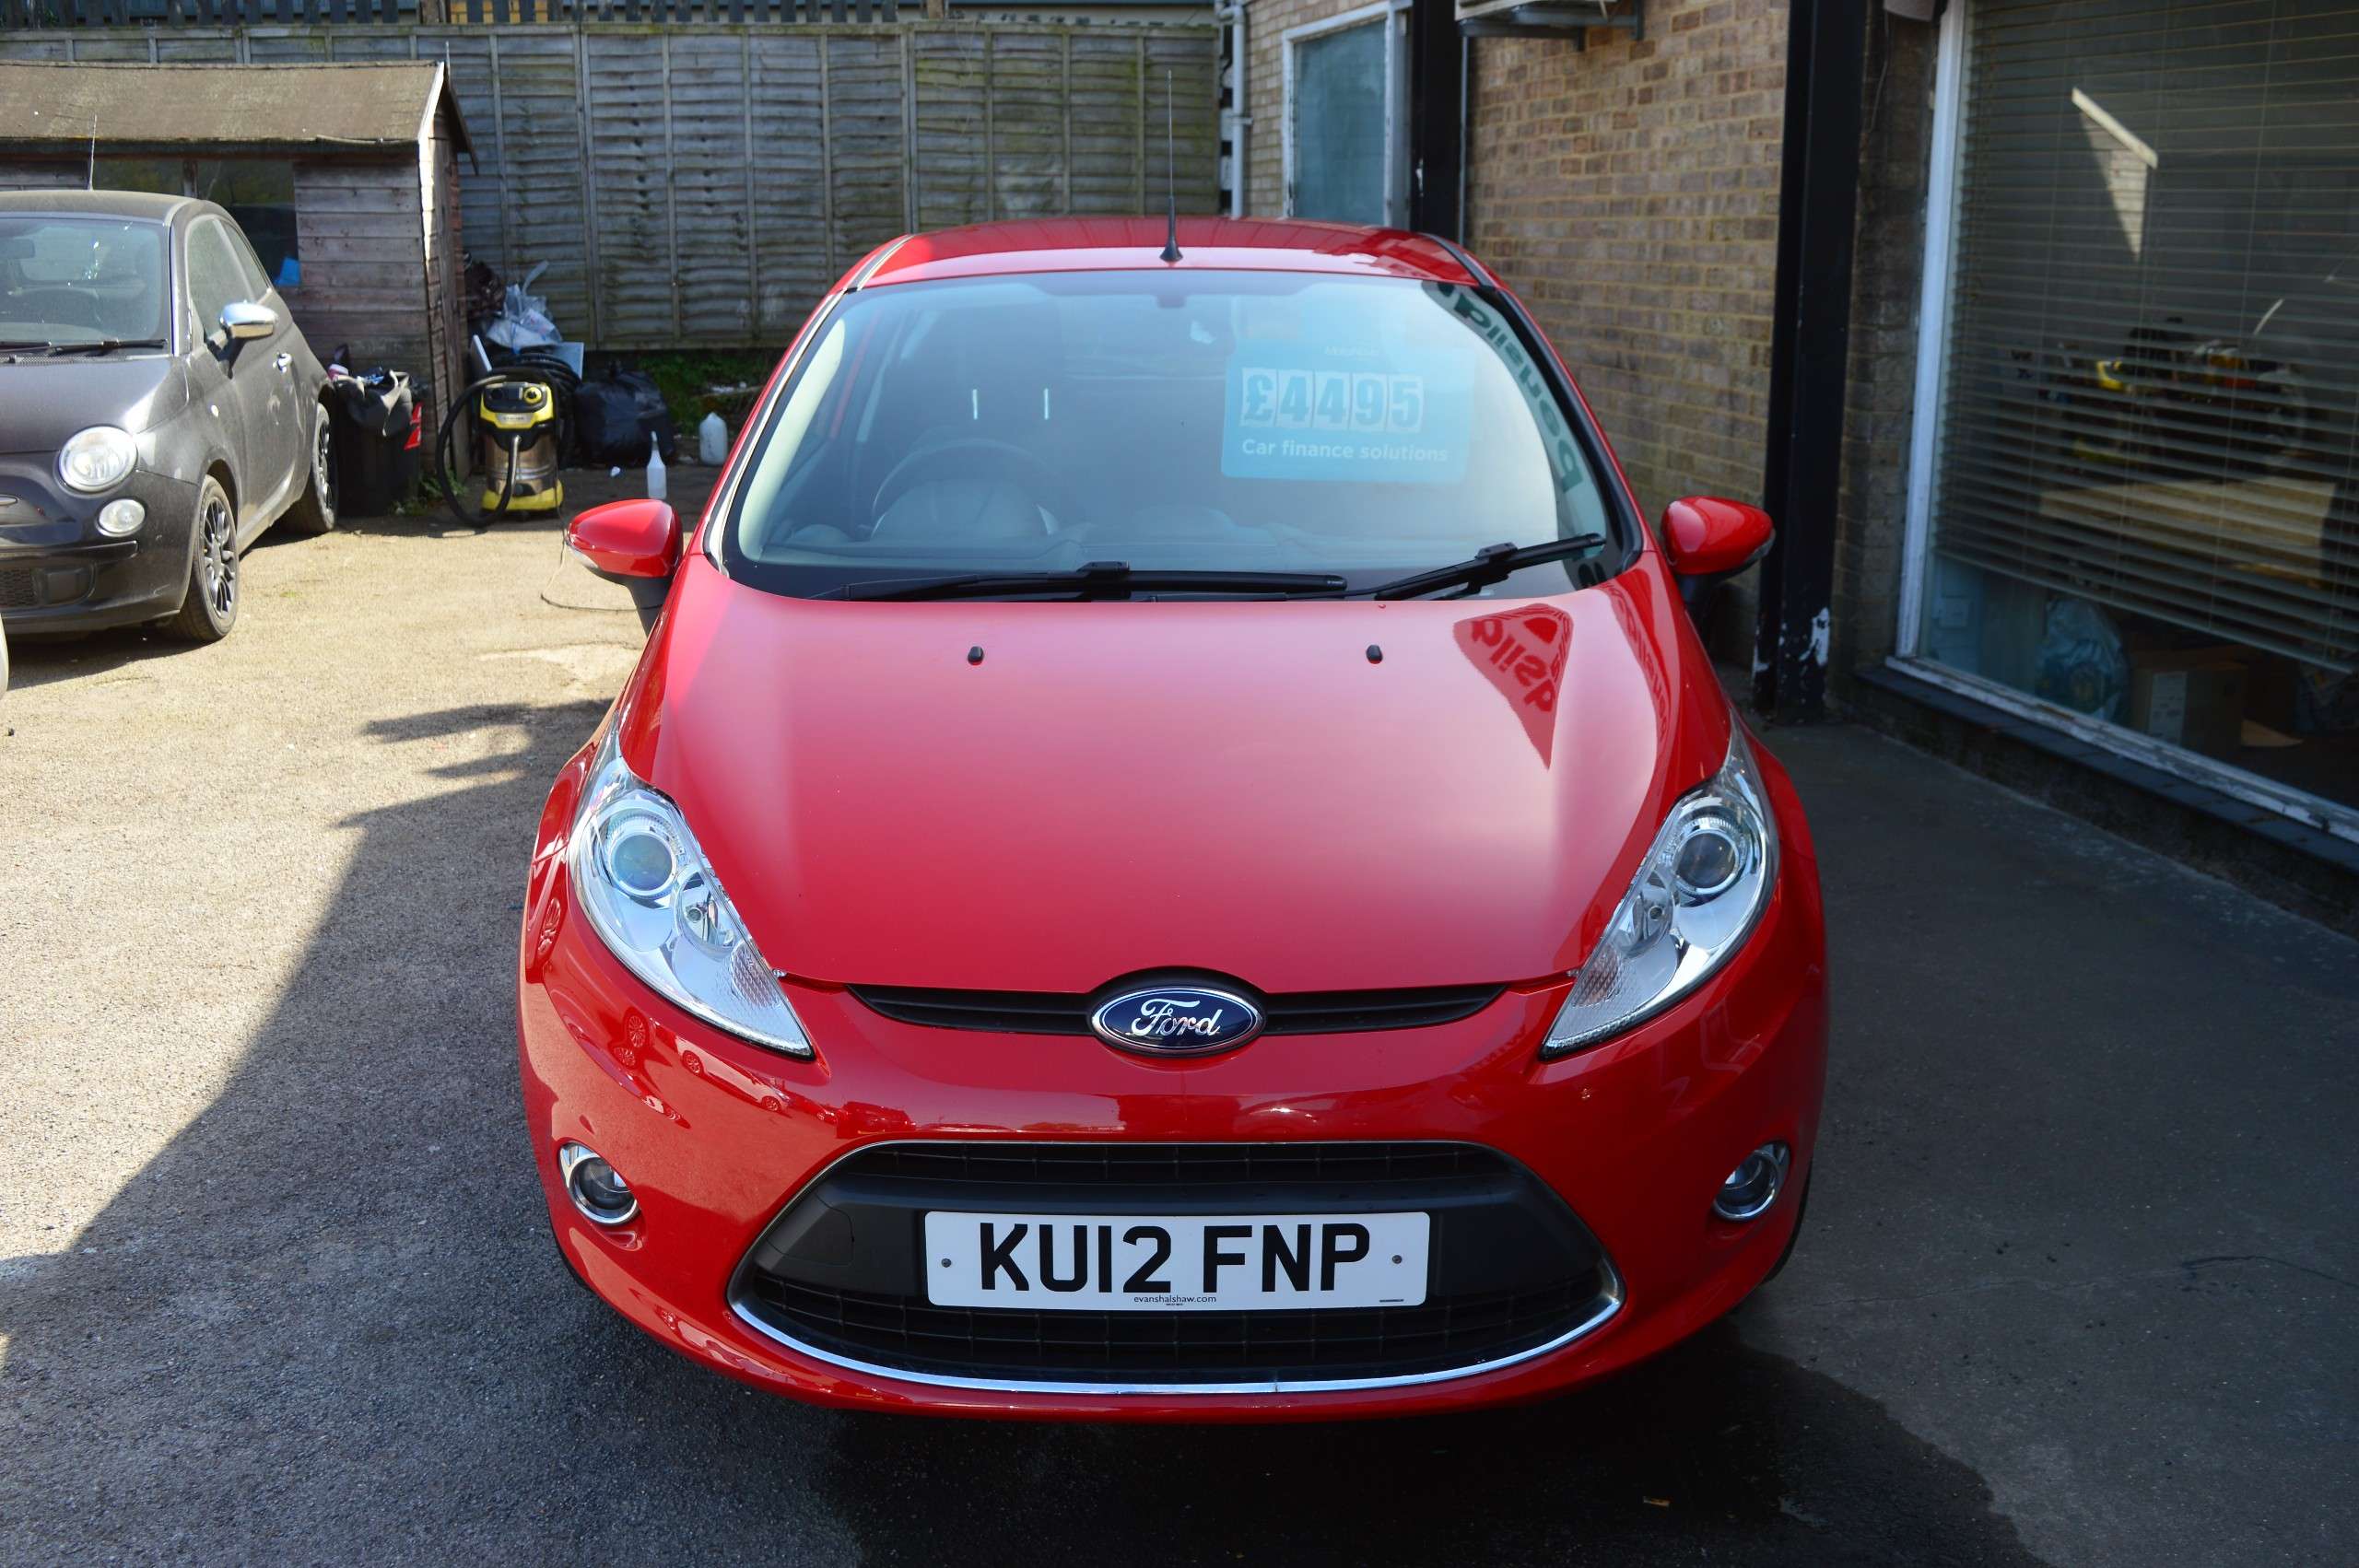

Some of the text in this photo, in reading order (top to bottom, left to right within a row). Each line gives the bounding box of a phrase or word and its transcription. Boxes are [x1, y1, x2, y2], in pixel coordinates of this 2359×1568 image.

[1245, 372, 1422, 429] £4495
[1242, 439, 1449, 462] Car finance solutions
[1125, 998, 1224, 1036] Ford
[980, 1223, 1370, 1293] KU12 FNP
[1133, 1294, 1217, 1304] evanshalshaw.com
